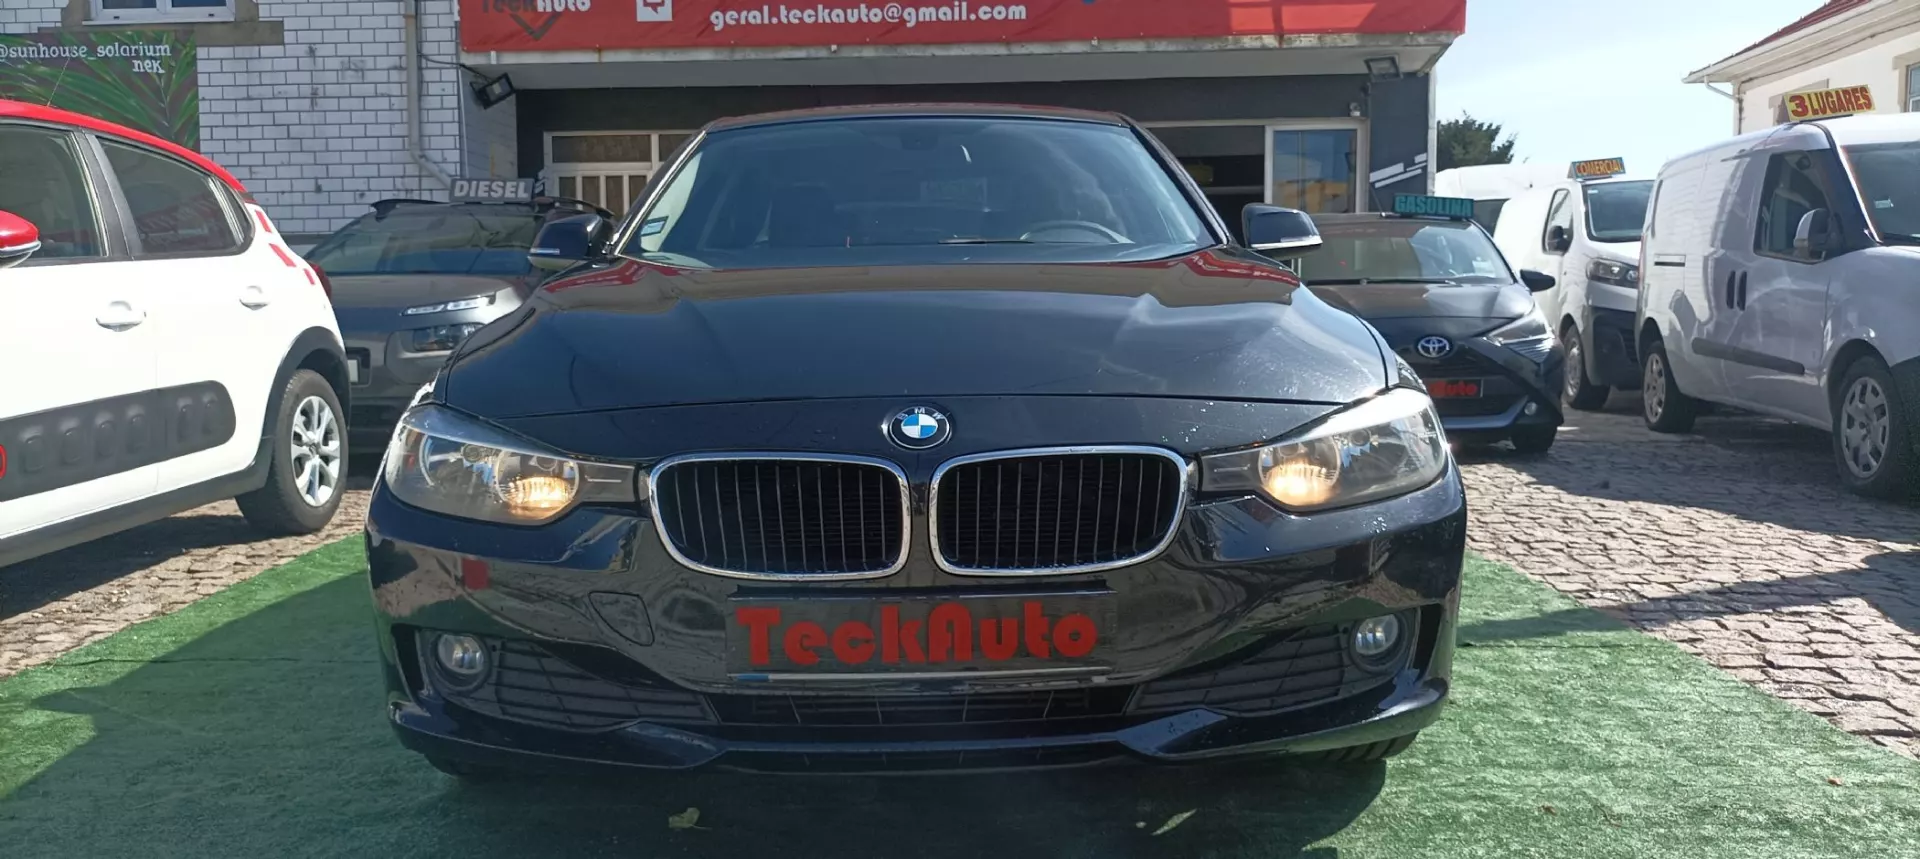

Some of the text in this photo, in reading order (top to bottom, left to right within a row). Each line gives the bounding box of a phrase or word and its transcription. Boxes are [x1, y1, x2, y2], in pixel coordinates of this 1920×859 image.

[709, 2, 1027, 31] geral.teckauto@gmail.com
[1788, 86, 1873, 118] 3 LUGARES
[1575, 159, 1625, 175] COMERCIAL
[453, 180, 529, 199] DIESEL
[1394, 194, 1473, 217] GASOLINA
[735, 600, 1098, 666] TeckAuto
